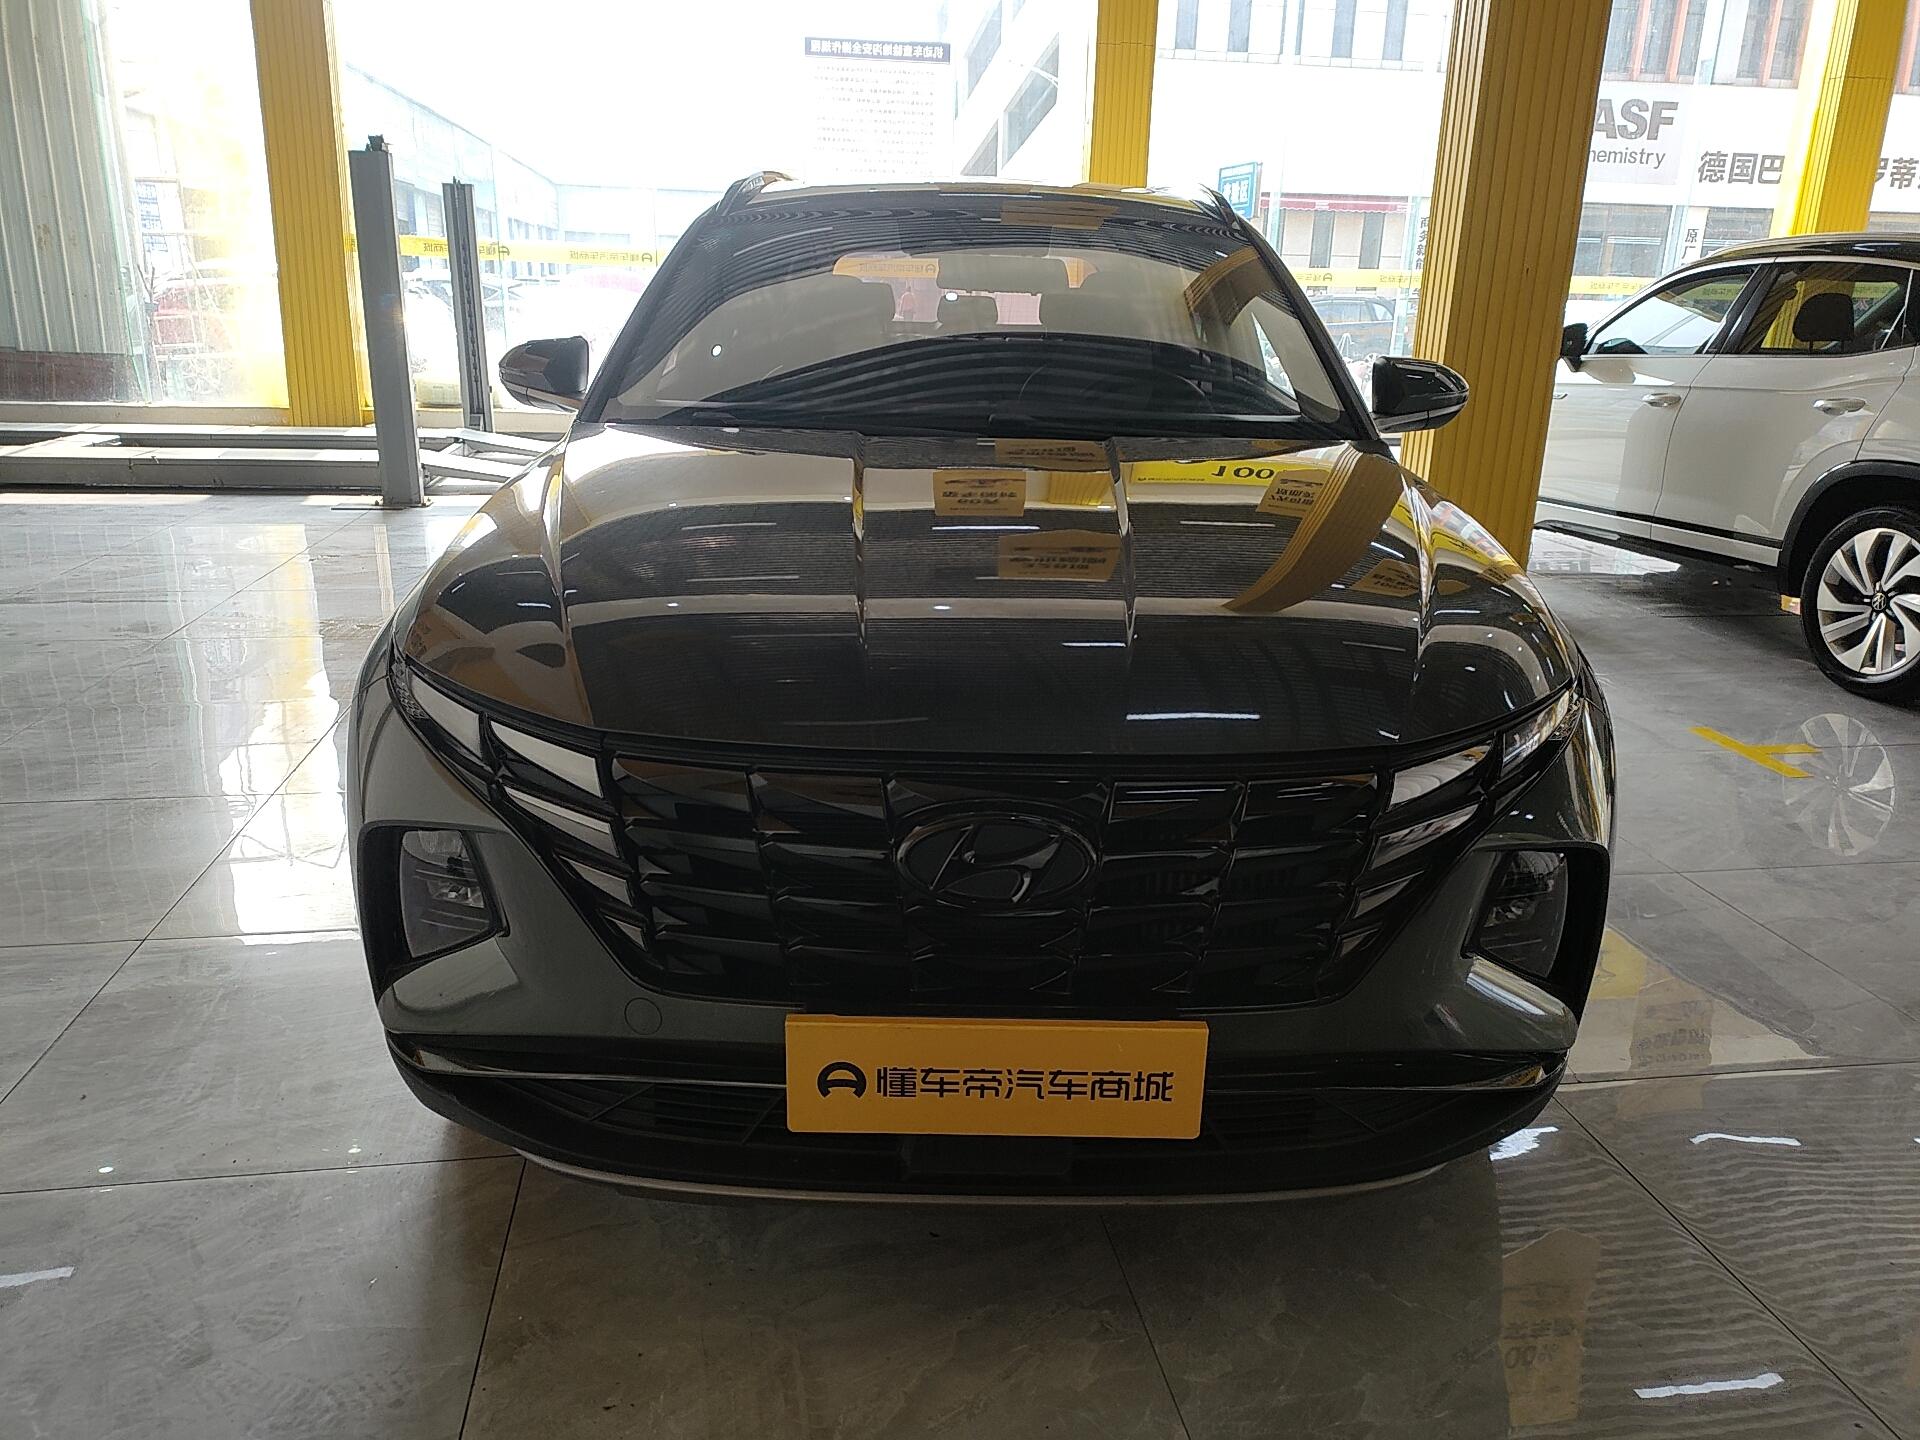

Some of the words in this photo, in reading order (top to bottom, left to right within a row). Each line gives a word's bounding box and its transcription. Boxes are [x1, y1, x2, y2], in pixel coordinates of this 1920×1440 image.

[876, 1066, 1174, 1102] 懂车帝汽车商城
